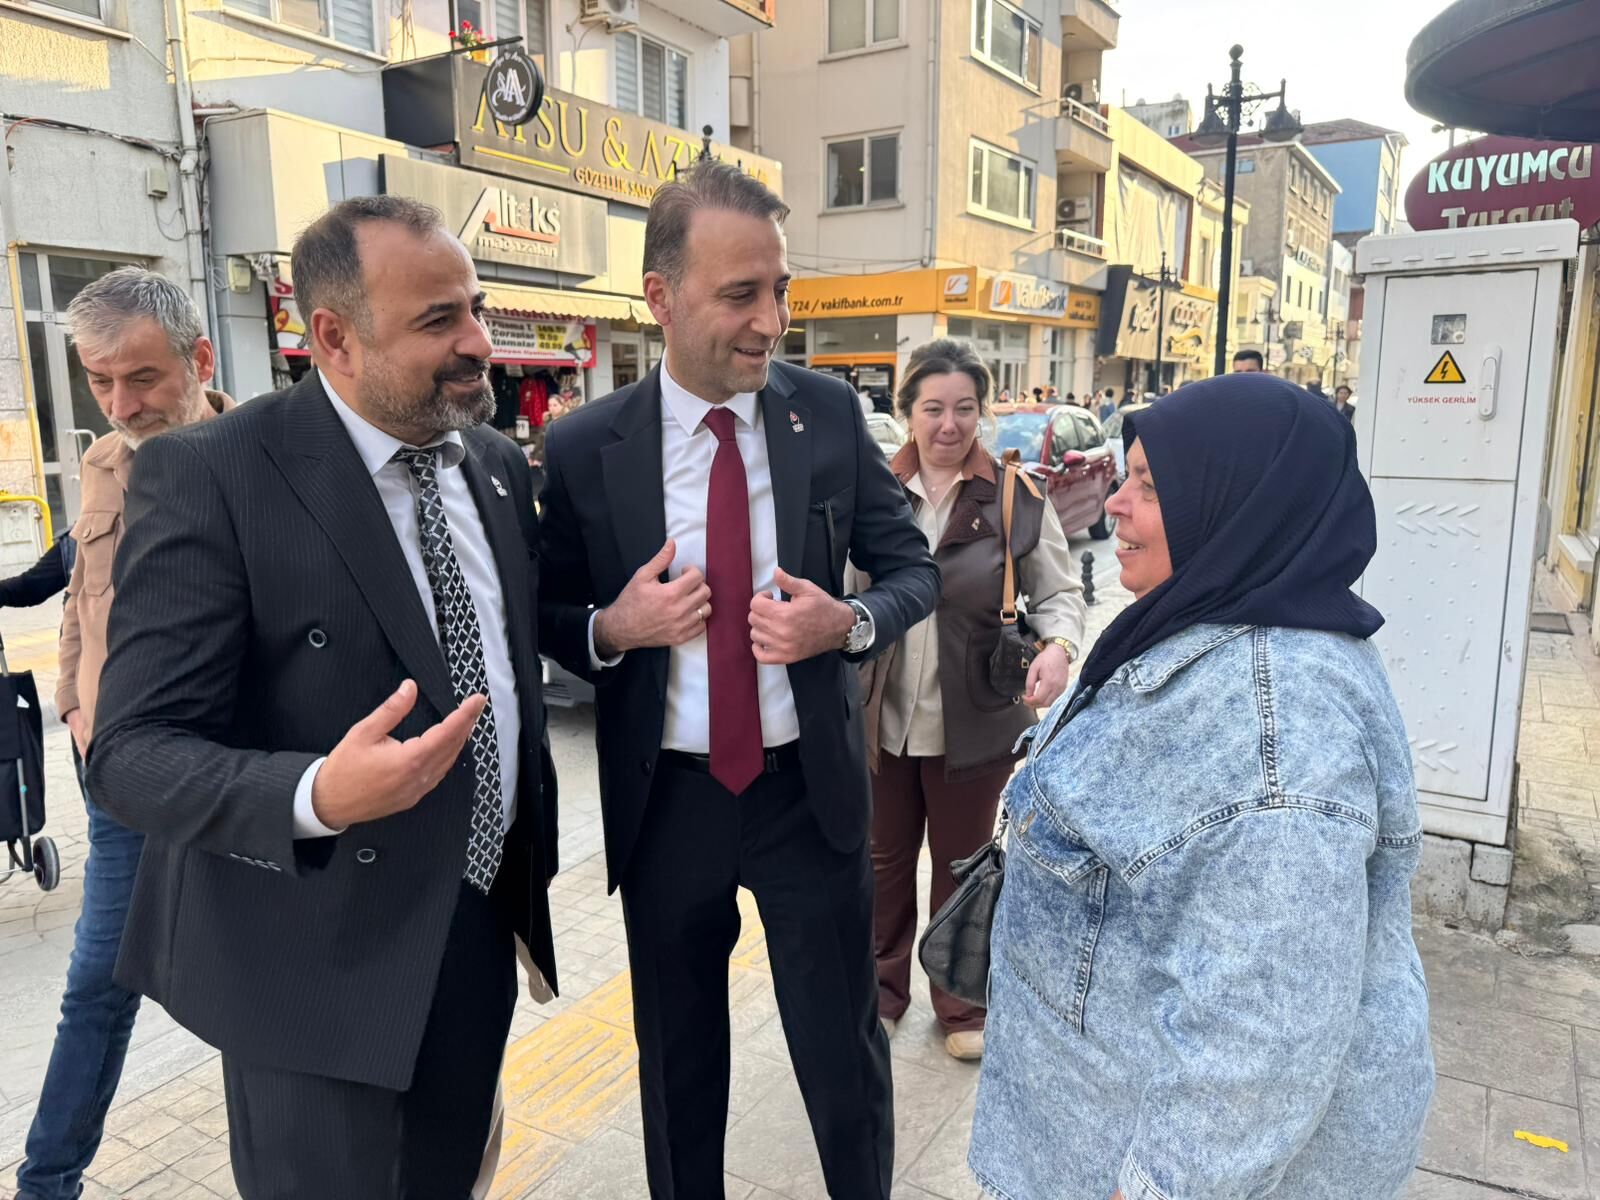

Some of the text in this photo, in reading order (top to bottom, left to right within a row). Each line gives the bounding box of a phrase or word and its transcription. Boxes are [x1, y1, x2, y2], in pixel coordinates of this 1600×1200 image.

[471, 88, 589, 158] ASU
[602, 116, 634, 171] &
[1427, 145, 1593, 194] KUYUMCU
[792, 300, 809, 312] 724
[821, 295, 904, 311] vakifbank.com.tr
[1407, 396, 1477, 404] YÜKSEK GERİLİM
